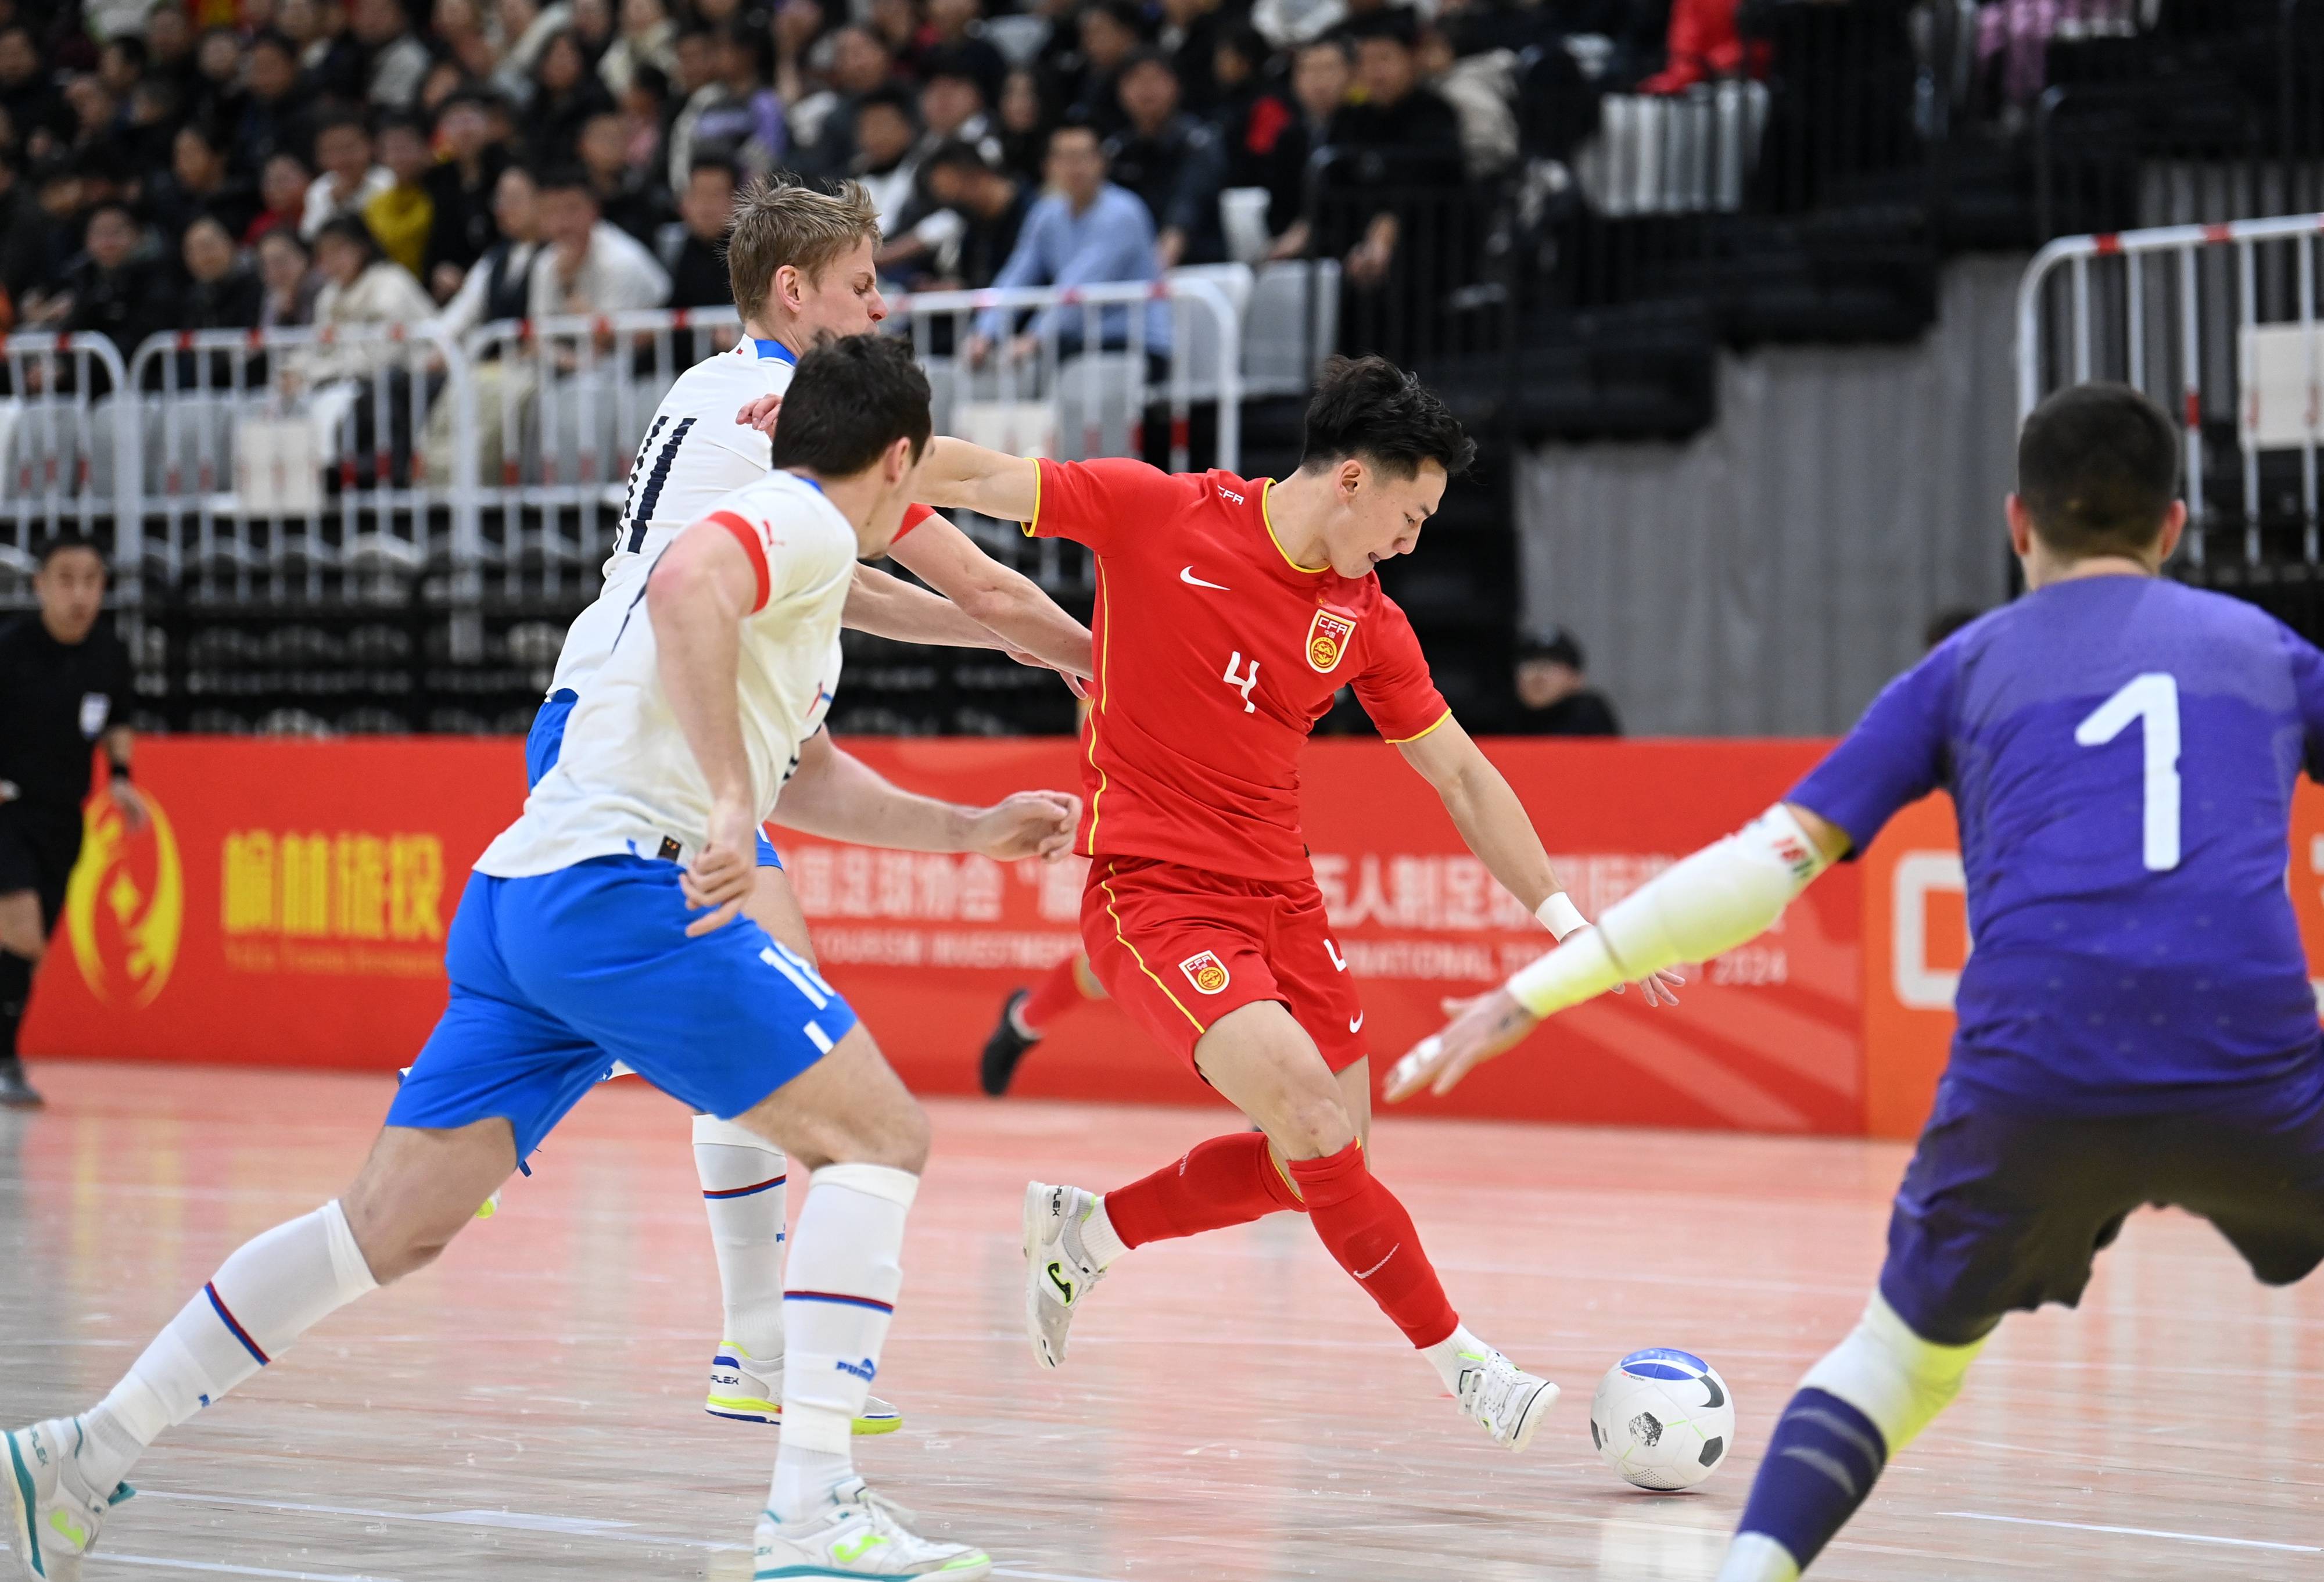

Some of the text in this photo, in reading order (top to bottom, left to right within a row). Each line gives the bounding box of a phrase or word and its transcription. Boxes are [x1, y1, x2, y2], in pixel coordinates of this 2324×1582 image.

[615, 415, 698, 554] 11
[1317, 616, 1349, 636] CFA
[1222, 651, 1260, 713] 4
[2074, 672, 2181, 871] 1
[1186, 955, 1212, 971] CFA
